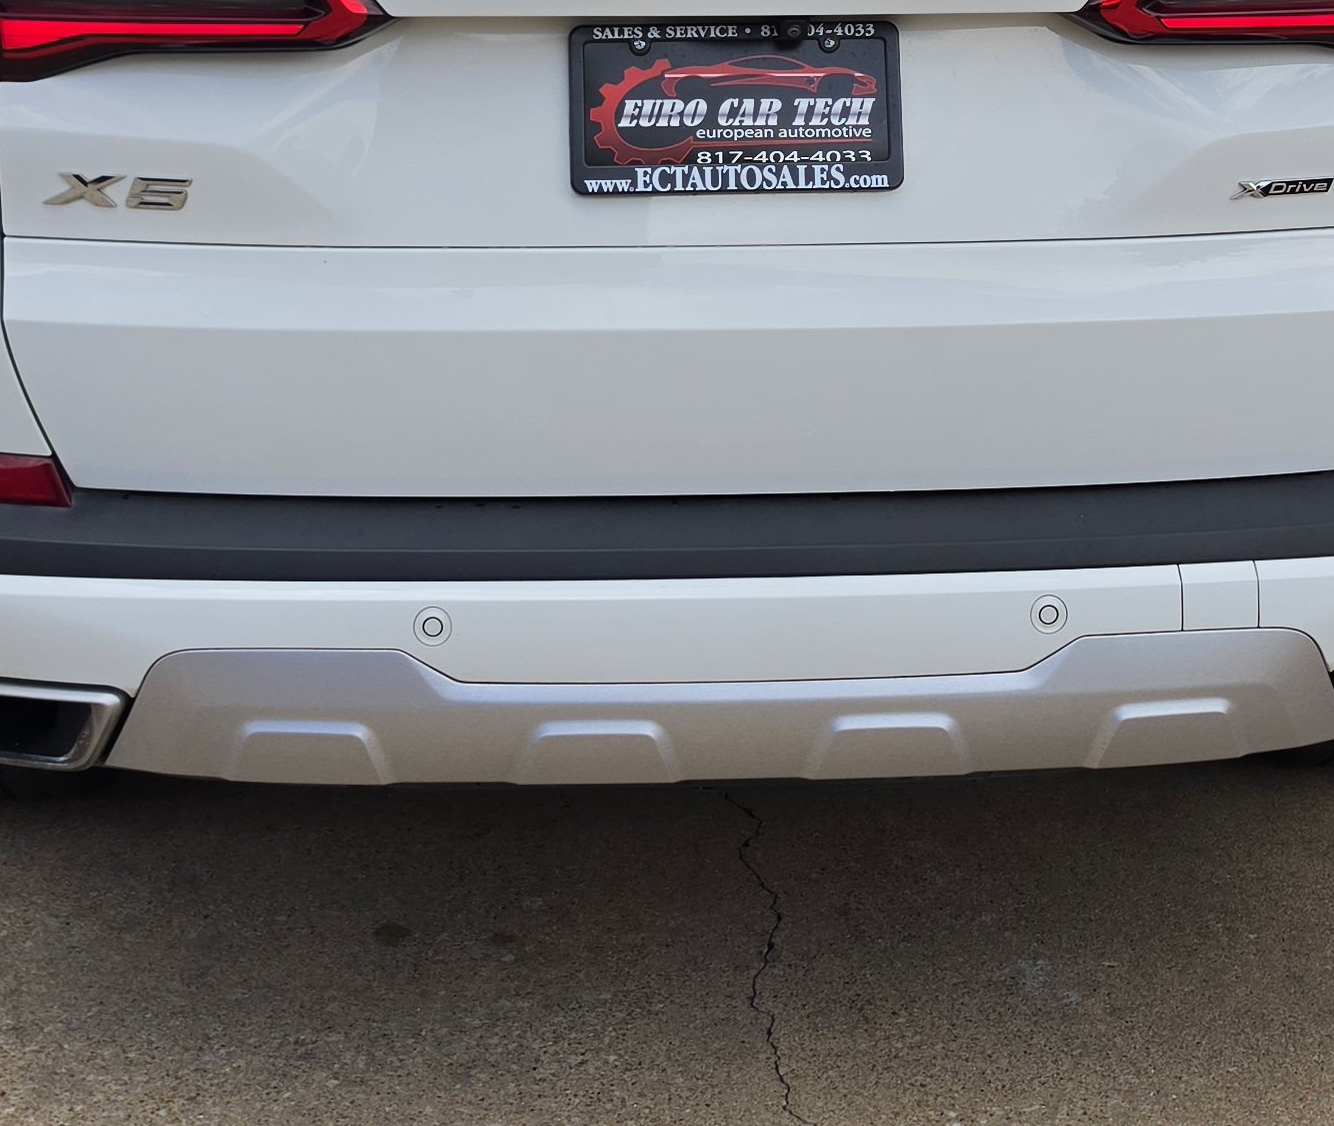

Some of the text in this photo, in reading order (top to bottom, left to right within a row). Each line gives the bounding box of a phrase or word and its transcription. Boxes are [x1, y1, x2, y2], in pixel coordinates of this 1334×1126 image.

[592, 26, 643, 40] SALES
[647, 26, 662, 39] &
[665, 25, 738, 39] SERVICE
[618, 97, 877, 128] EURO CAR TECH
[696, 125, 873, 141] european automotive
[696, 150, 872, 164] 817-404-4033
[584, 164, 890, 193] www.ECTAUTOSALES.com
